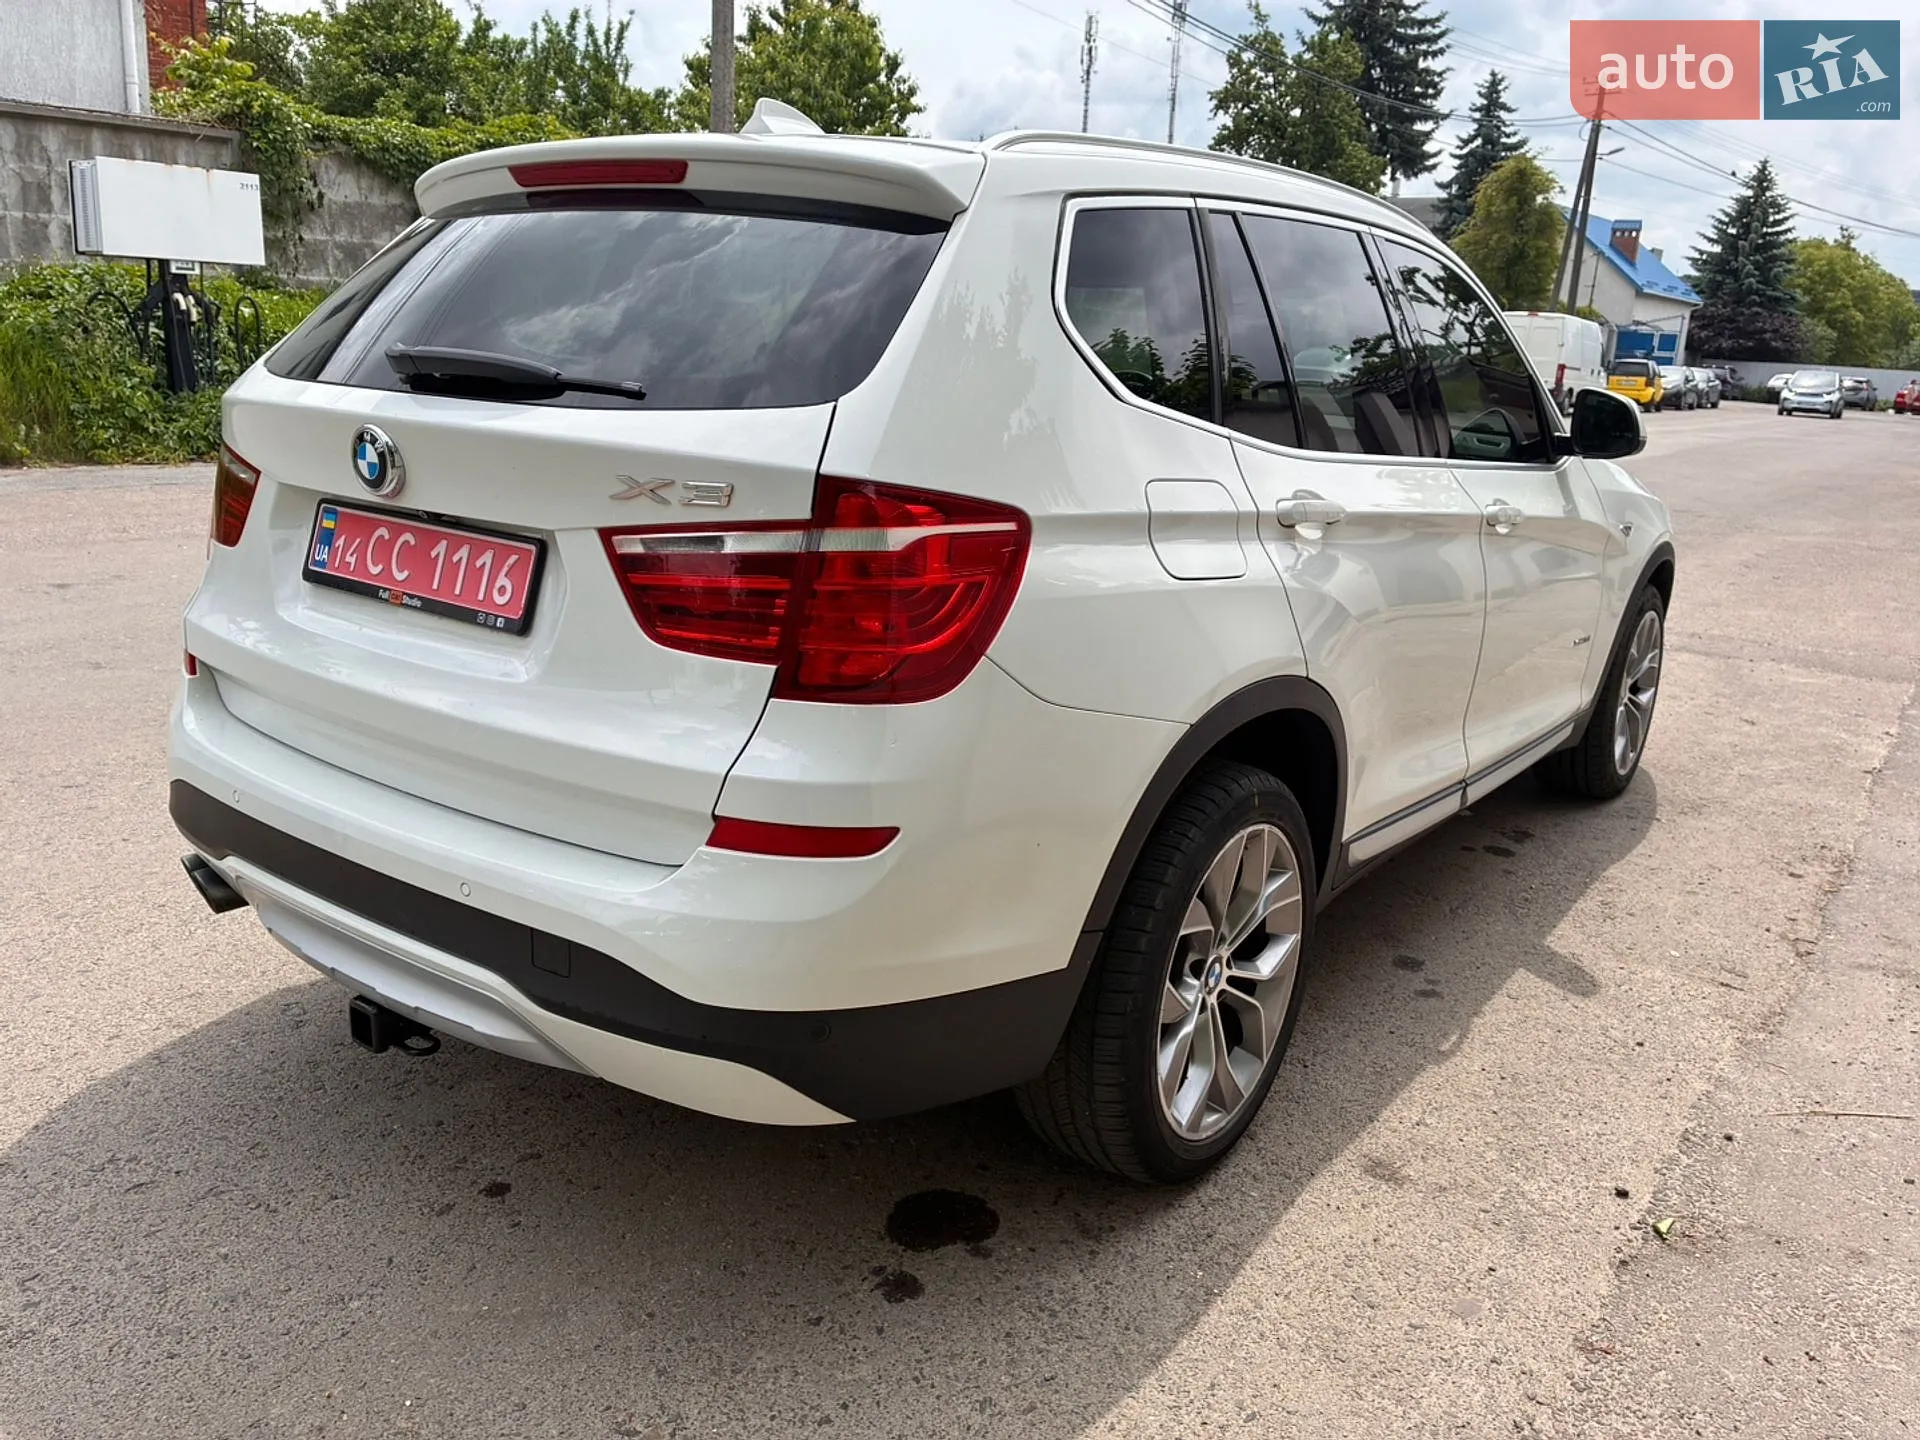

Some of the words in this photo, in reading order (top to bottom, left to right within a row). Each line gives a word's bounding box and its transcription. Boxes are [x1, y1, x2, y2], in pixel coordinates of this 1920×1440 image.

[608, 474, 734, 508] X3
[314, 543, 329, 562] UA
[430, 539, 519, 605] 1116
